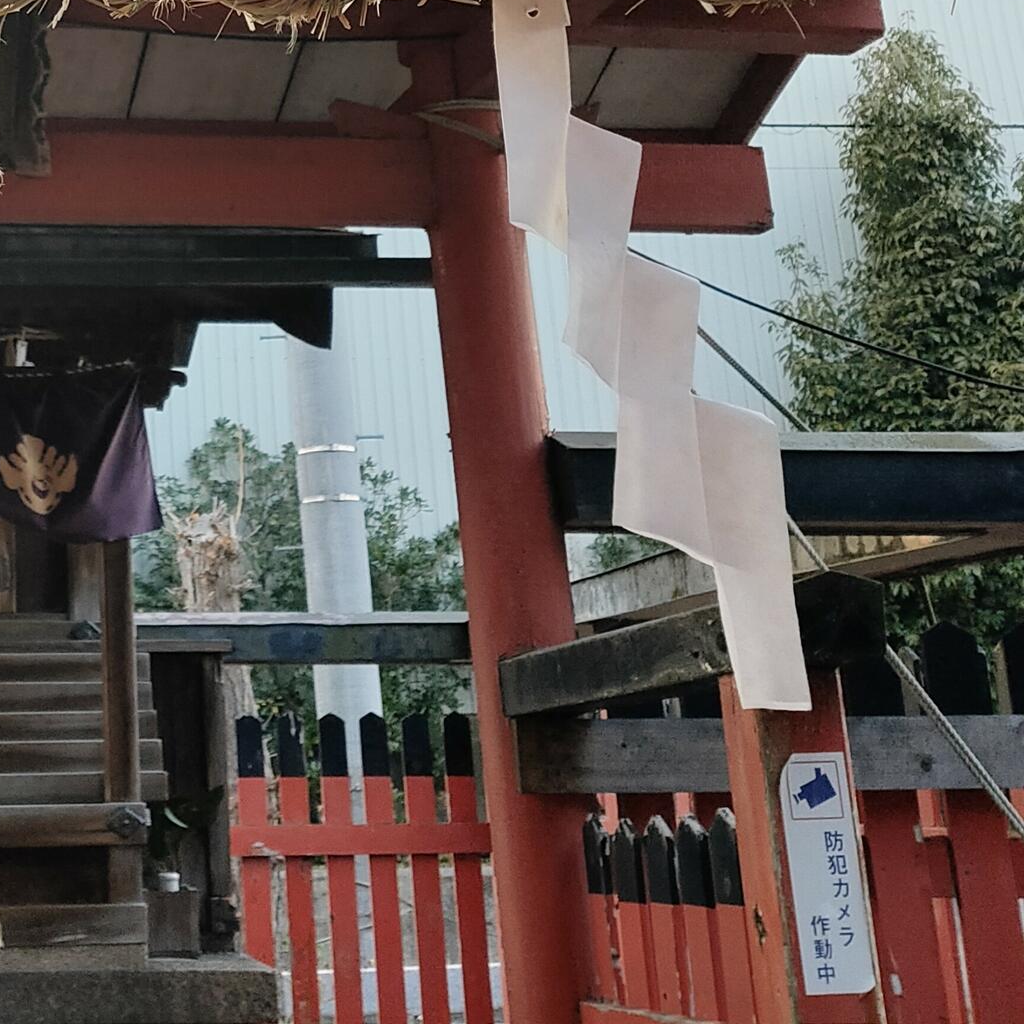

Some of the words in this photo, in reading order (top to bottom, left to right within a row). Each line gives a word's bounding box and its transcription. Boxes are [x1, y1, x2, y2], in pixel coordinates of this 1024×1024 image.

[823, 830, 855, 947] 防犯カメラ
[810, 915, 836, 985] 作動中
